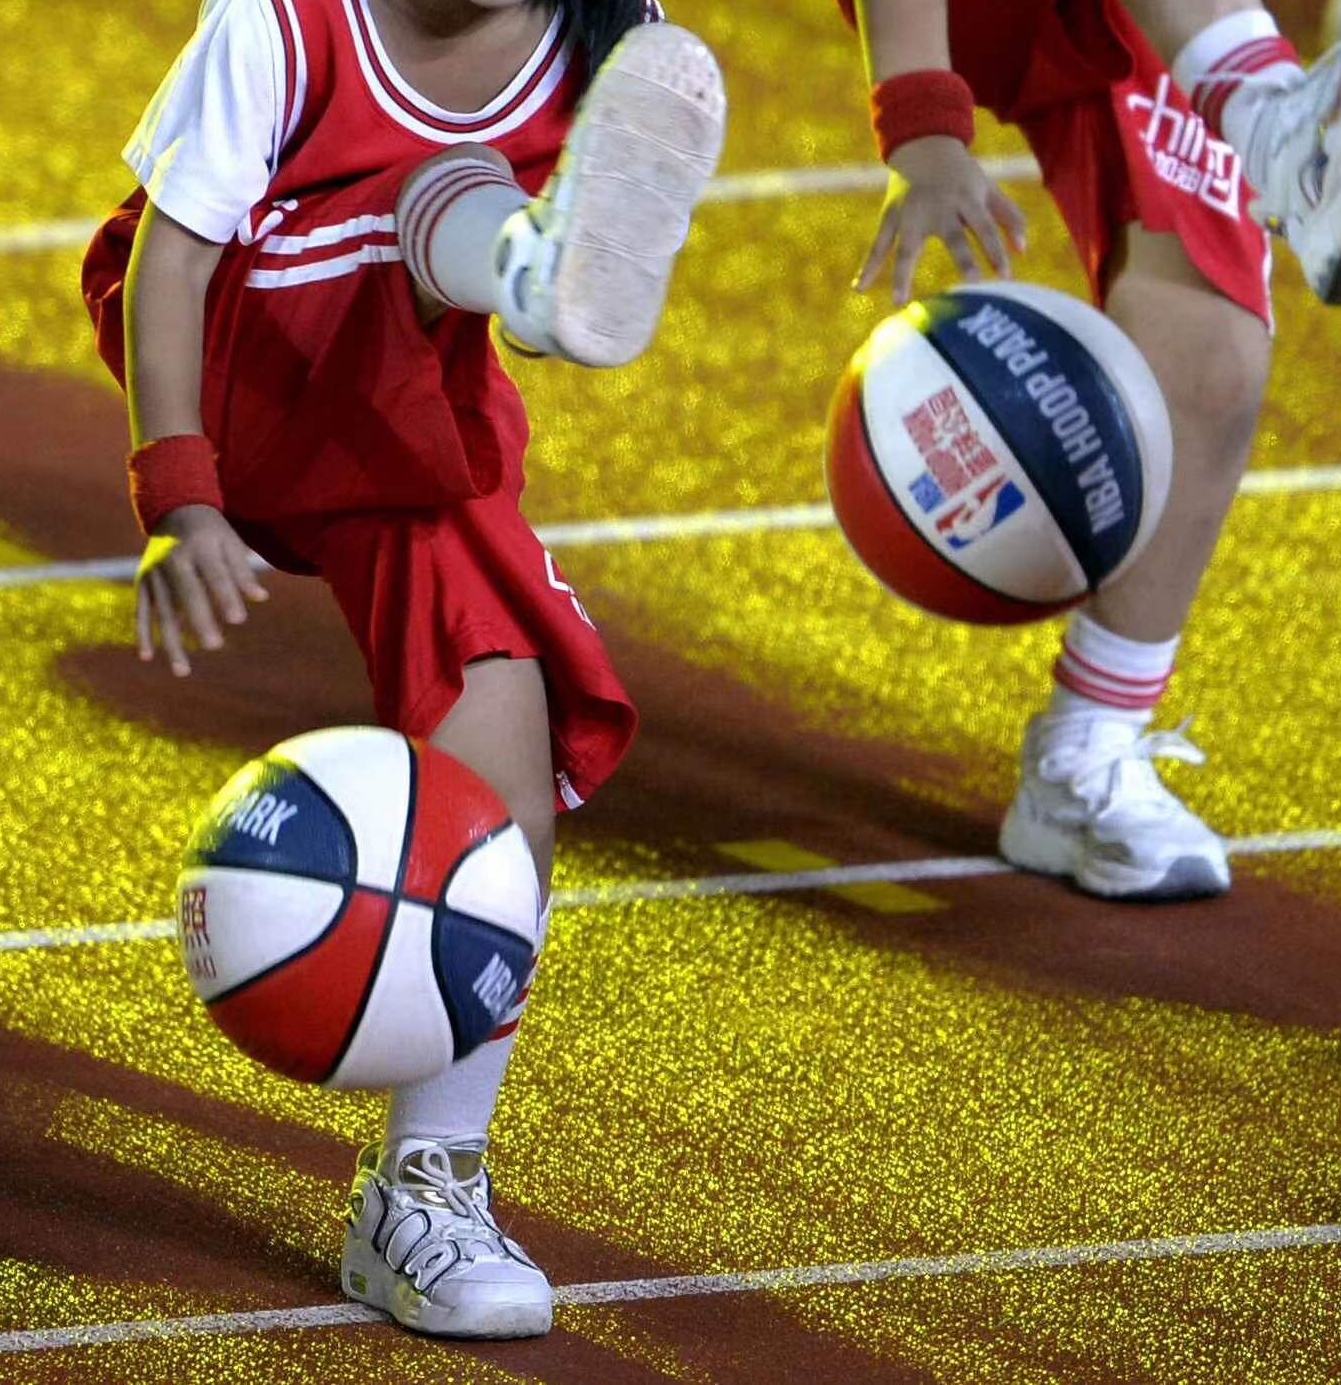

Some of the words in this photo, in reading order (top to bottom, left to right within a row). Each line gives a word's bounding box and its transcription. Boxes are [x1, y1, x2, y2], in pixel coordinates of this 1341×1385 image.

[957, 303, 1049, 378] PARK
[1025, 374, 1104, 464] HOOP
[1076, 454, 1125, 535] NBA
